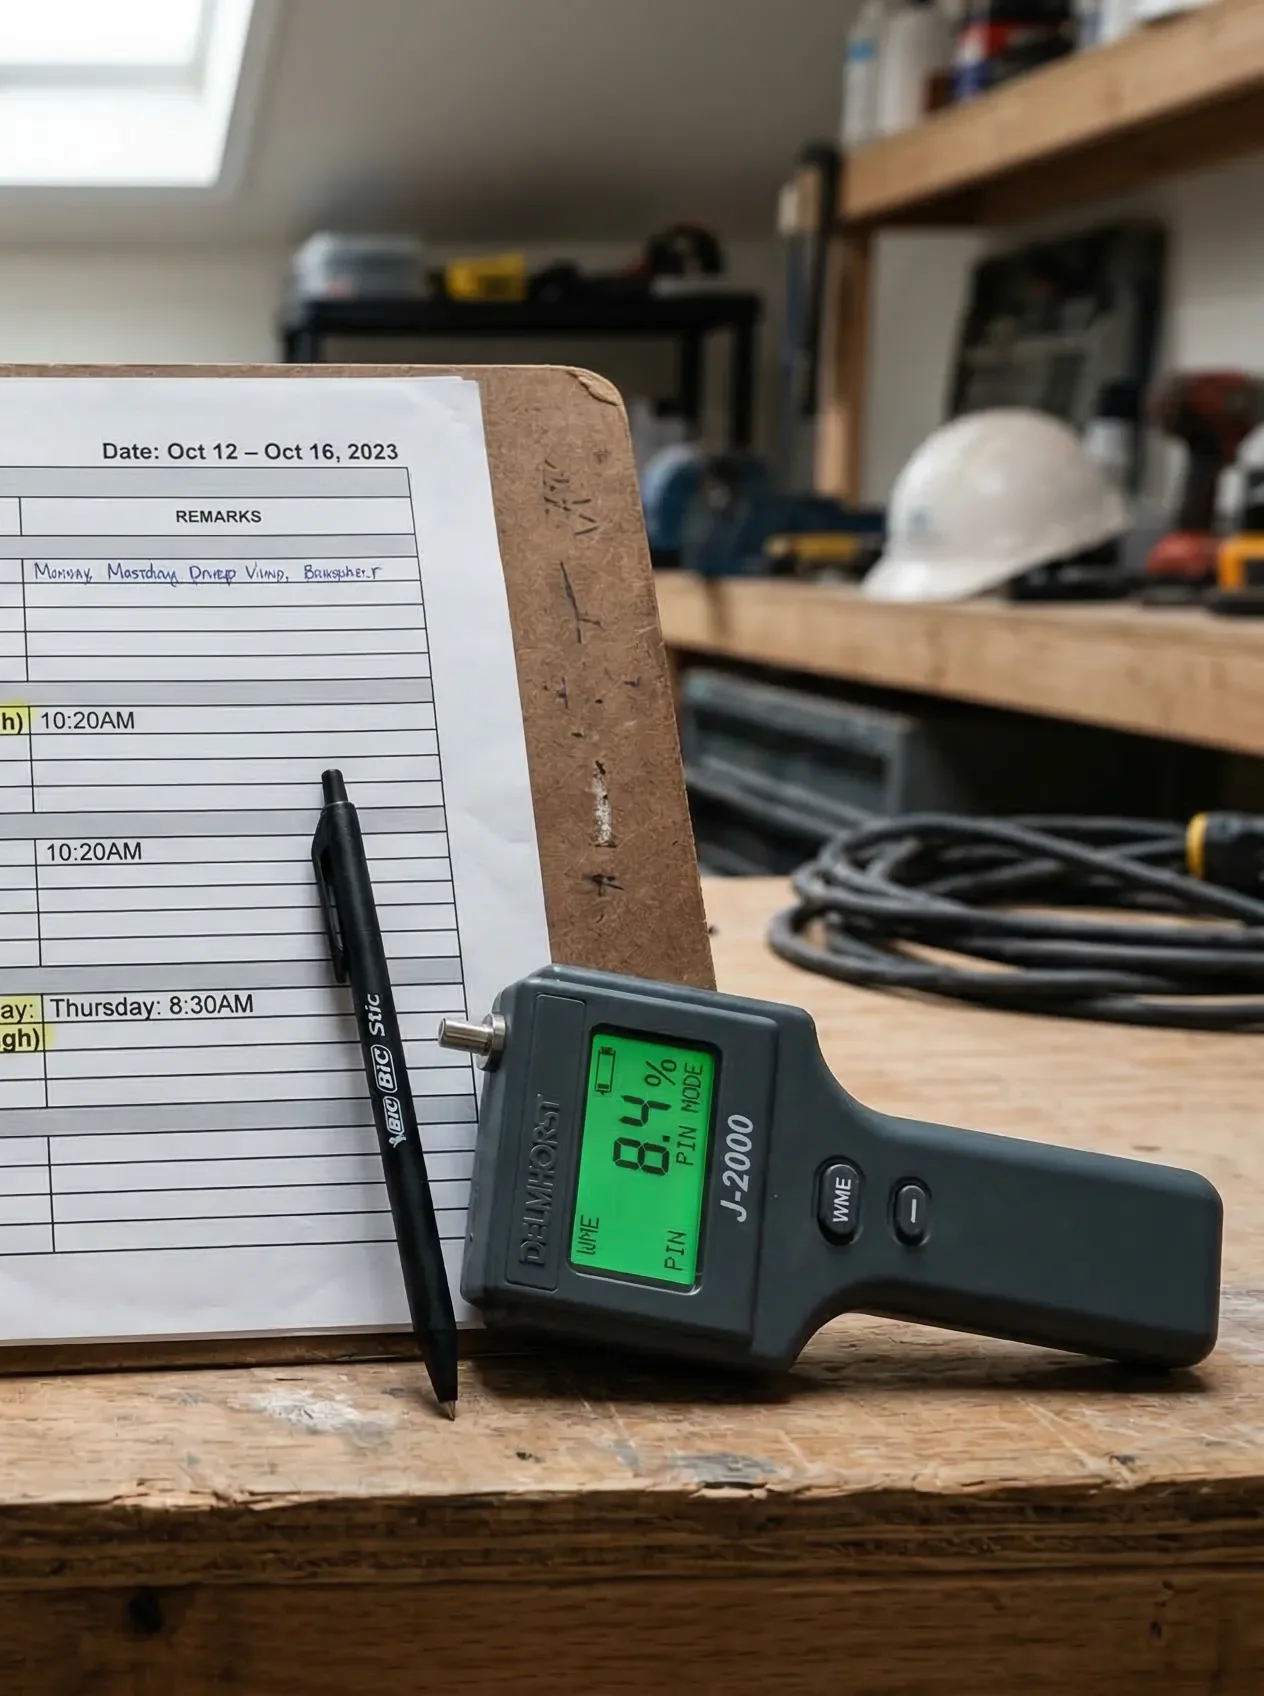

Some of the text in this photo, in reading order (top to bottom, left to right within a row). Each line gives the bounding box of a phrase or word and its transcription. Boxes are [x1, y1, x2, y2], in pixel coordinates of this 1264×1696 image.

[102, 442, 160, 460] Date:
[167, 442, 207, 461] Oct
[212, 442, 239, 460] 12
[264, 442, 304, 461] Oct
[309, 442, 341, 464] 16,
[347, 442, 399, 461] 2023
[175, 509, 262, 524] REMARKS
[40, 710, 135, 730] 10:20AM
[46, 841, 142, 862] 10:20AM
[49, 993, 254, 1019] Thursday: 8:30AM
[365, 993, 386, 1037] Stic
[386, 1098, 403, 1132] BIC
[675, 1062, 704, 1166] PIN MODE
[520, 1094, 561, 1266] DELMHORST
[720, 1114, 754, 1223] J-2000
[832, 1176, 852, 1223] WME
[577, 1214, 600, 1256] WME
[663, 1230, 687, 1271] PIN
